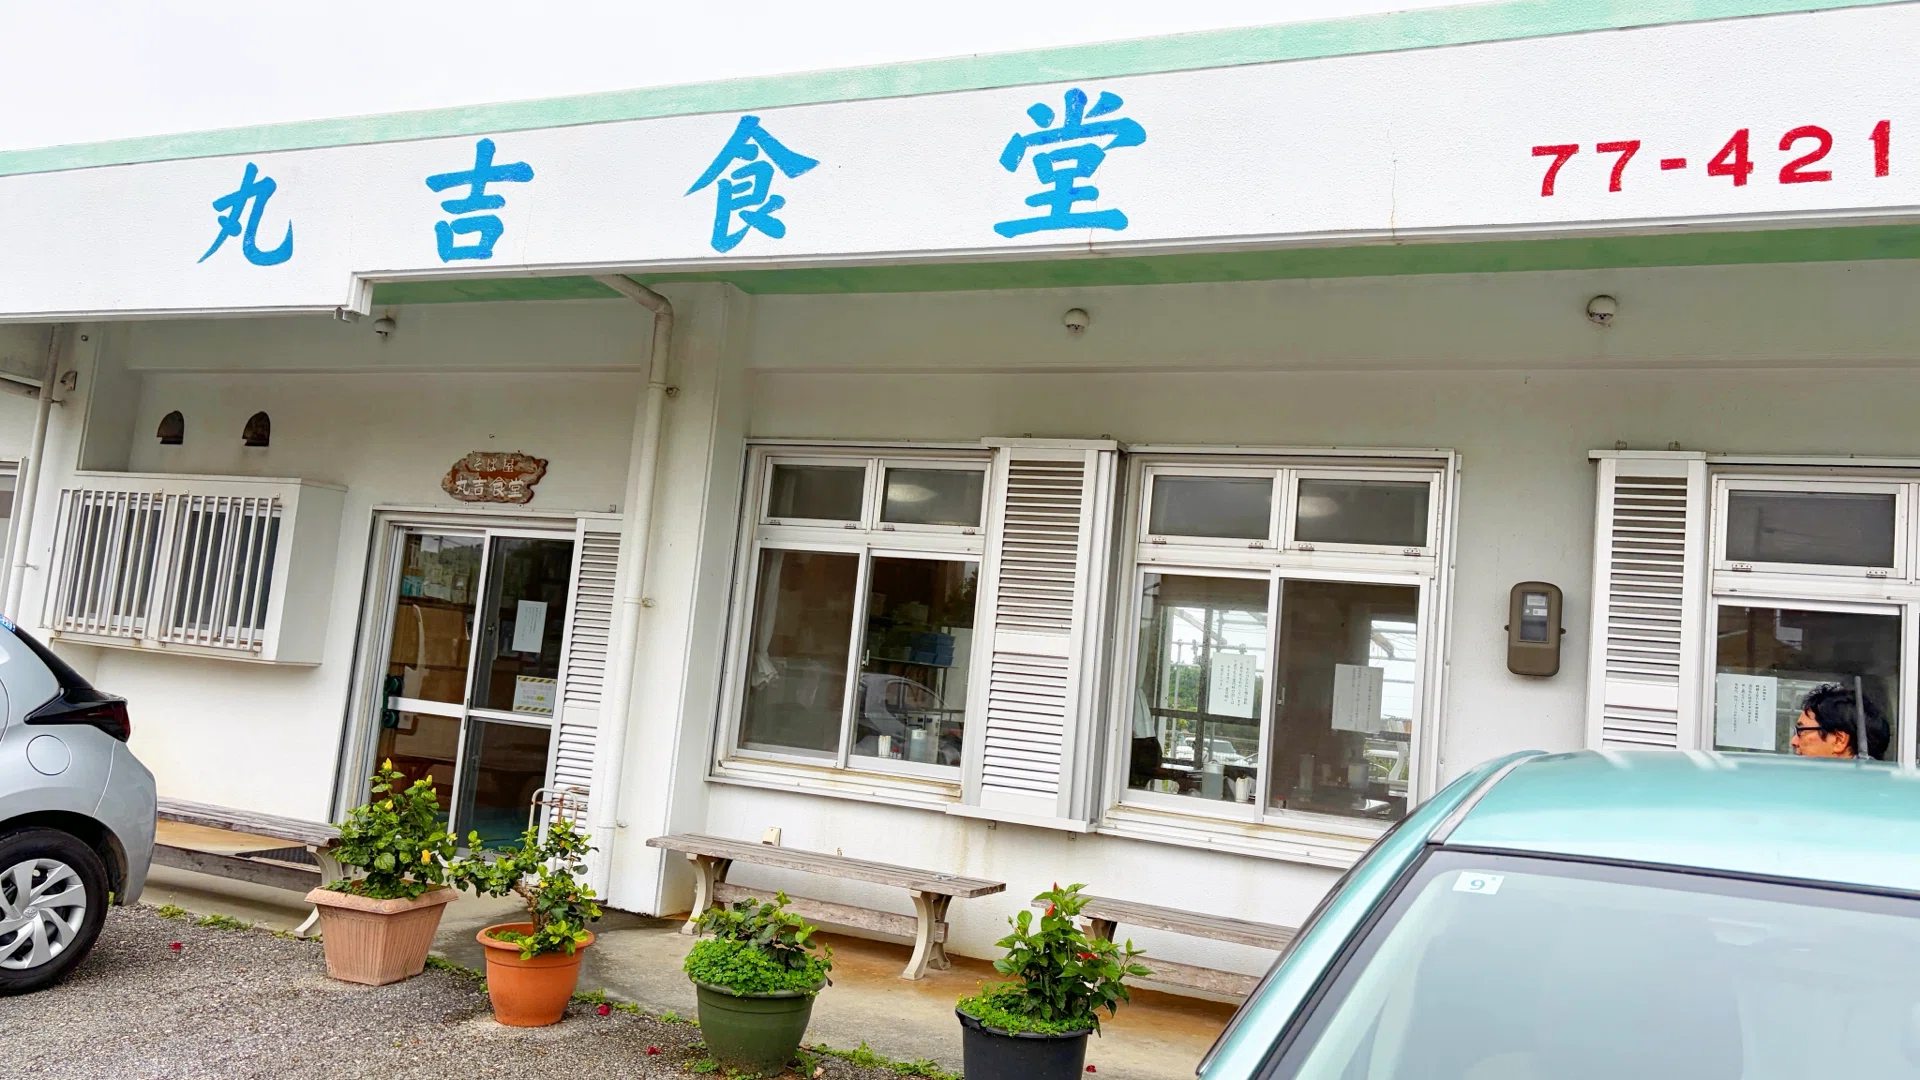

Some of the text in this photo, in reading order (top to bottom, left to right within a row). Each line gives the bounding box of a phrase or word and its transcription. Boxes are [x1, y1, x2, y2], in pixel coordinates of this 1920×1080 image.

[1532, 120, 1890, 196] 77-421
[199, 88, 1146, 266] 丸吉食堂
[473, 457, 514, 473] そば屋
[455, 476, 524, 498] 丸吉食堂
[1469, 879, 1486, 891] 9
